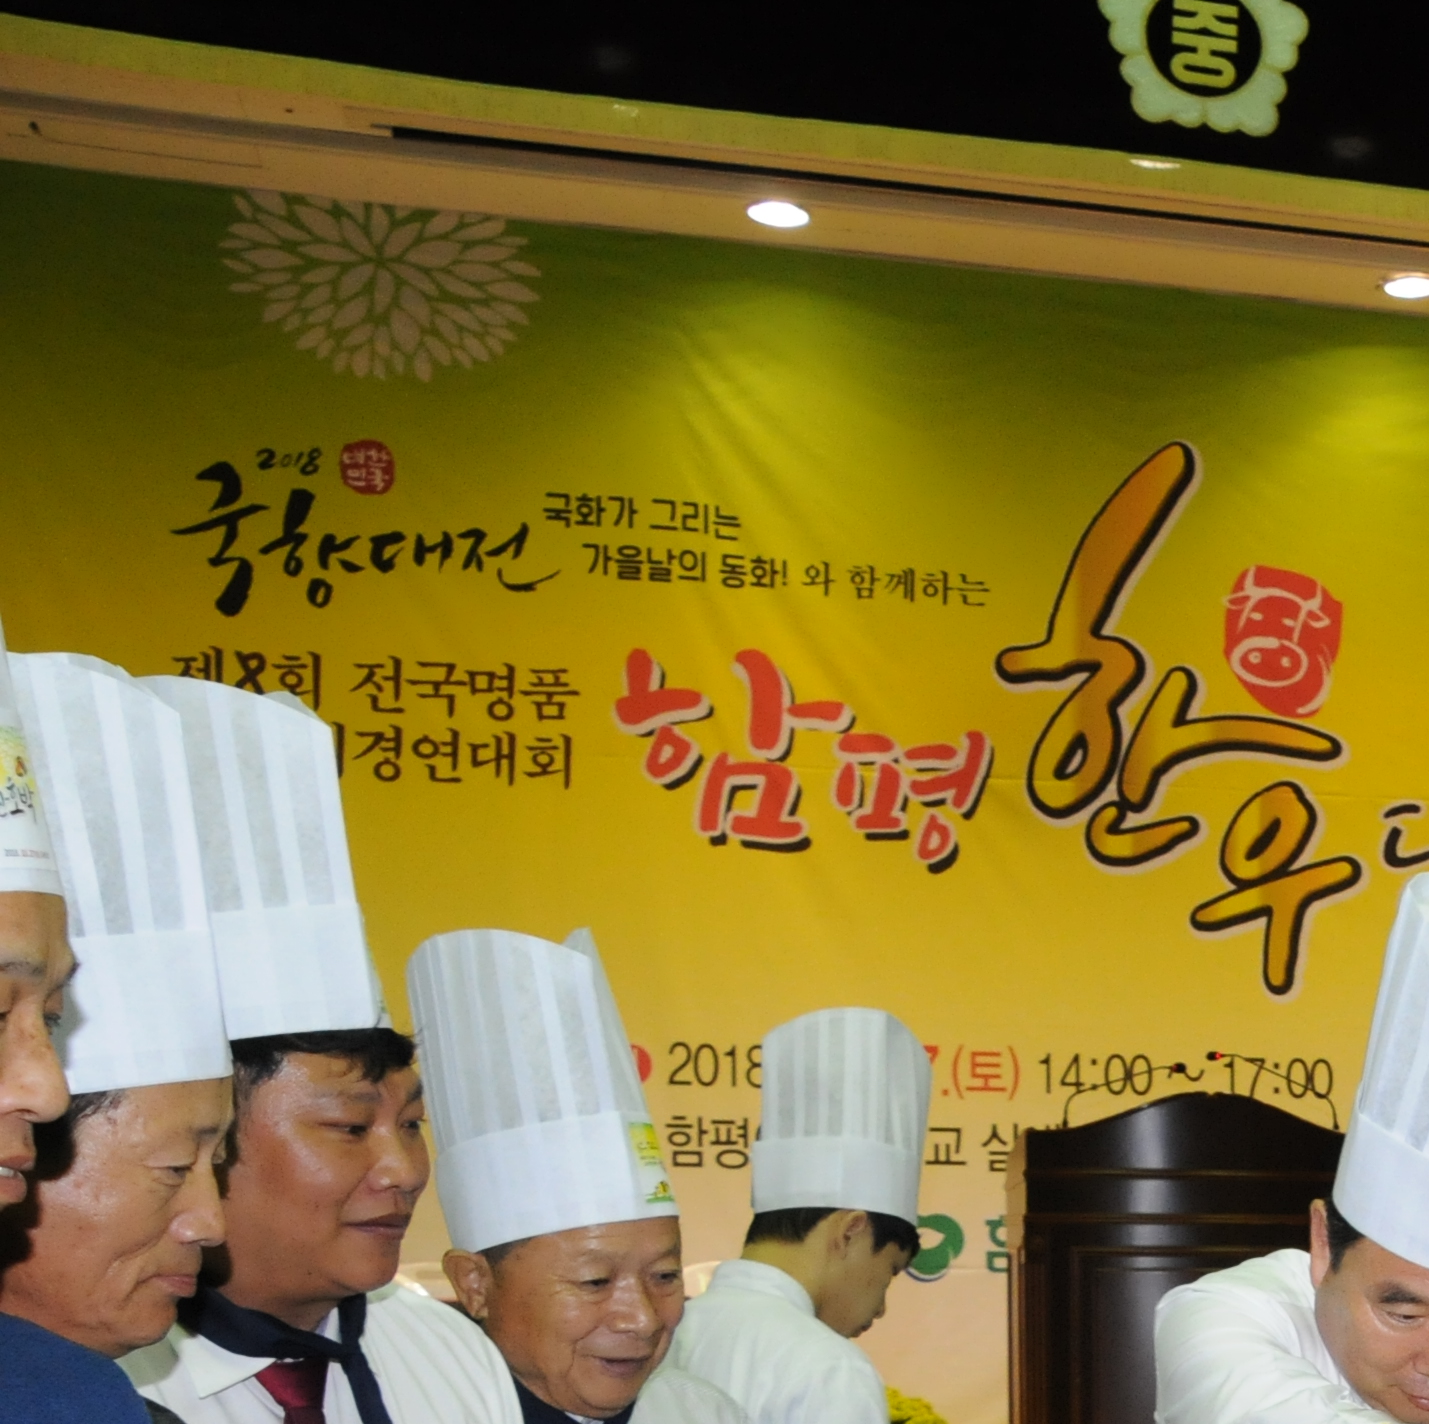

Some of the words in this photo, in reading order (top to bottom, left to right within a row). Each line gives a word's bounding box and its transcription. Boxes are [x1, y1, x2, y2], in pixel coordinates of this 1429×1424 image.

[256, 447, 323, 476] 2018
[170, 460, 562, 618] 국향대전
[543, 492, 638, 529] 국화가
[649, 498, 742, 541] 그리는
[582, 543, 706, 583] 가을날의
[719, 553, 788, 589] 동화!
[802, 561, 836, 597] 와
[847, 564, 991, 607] 함께하는
[349, 655, 581, 722] 전국명품
[614, 648, 993, 873] 함평
[994, 440, 1363, 996] 한우
[332, 721, 573, 790] 경연대회
[1038, 1053, 1153, 1096] 14:00
